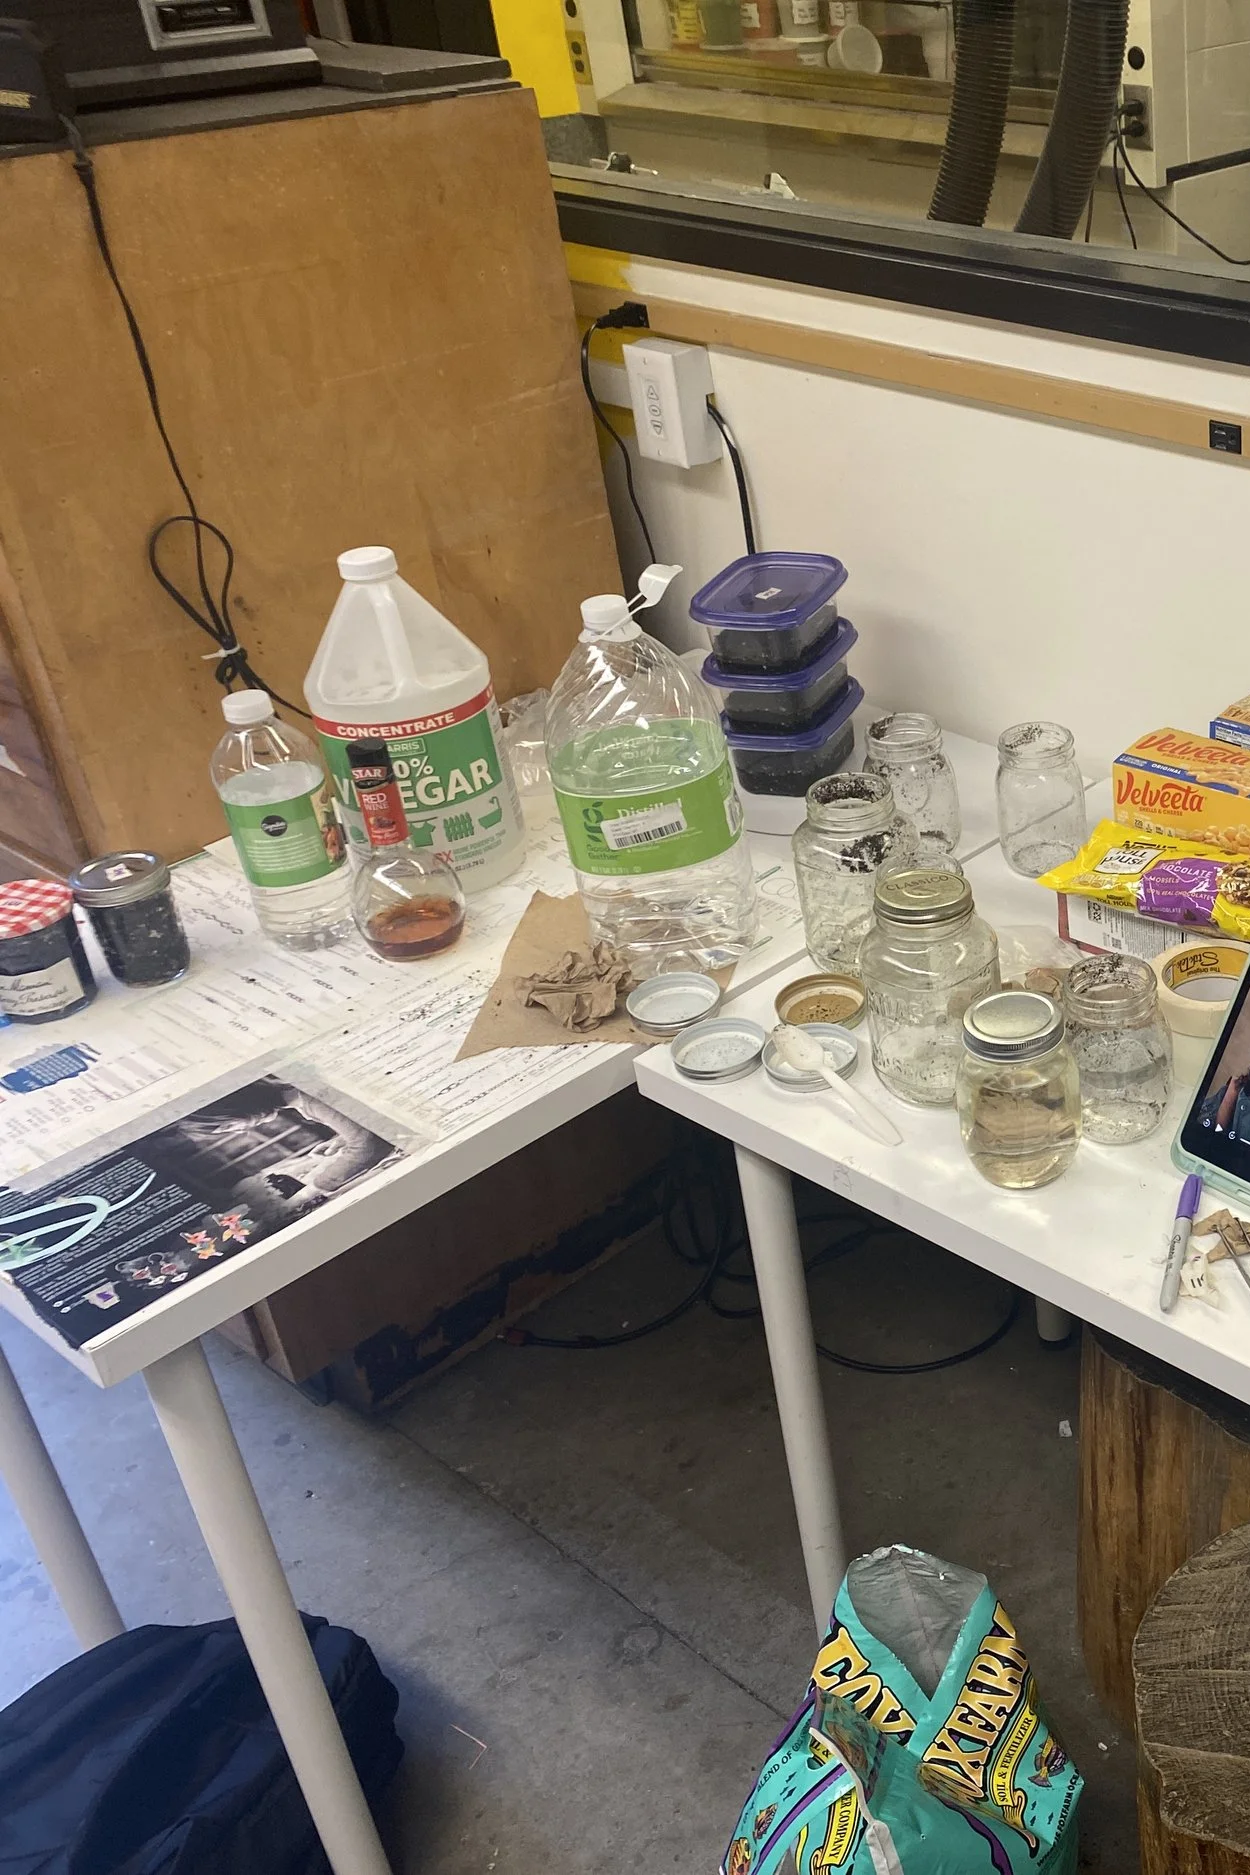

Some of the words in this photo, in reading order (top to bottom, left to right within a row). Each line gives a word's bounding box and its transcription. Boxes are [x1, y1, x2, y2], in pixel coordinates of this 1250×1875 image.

[336, 712, 455, 737] CONCENTRATE
[387, 741, 420, 753] ARRIS
[352, 768, 382, 780] STAR
[393, 755, 434, 780] 0%
[1151, 763, 1182, 775] ORIGINAL
[333, 757, 494, 810] VEGAR
[1117, 771, 1204, 812] Velveeta
[362, 793, 387, 804] RED
[364, 801, 389, 811] WINE
[822, 1749, 831, 1758] &
[1000, 1717, 1033, 1770] FERTILIZER
[757, 1763, 780, 1793] BLEND
[781, 1750, 794, 1765] OF
[997, 1782, 1009, 1804] SOIL
[1058, 1791, 1074, 1834] FOXFARM
[828, 1810, 851, 1859] COMPANY
